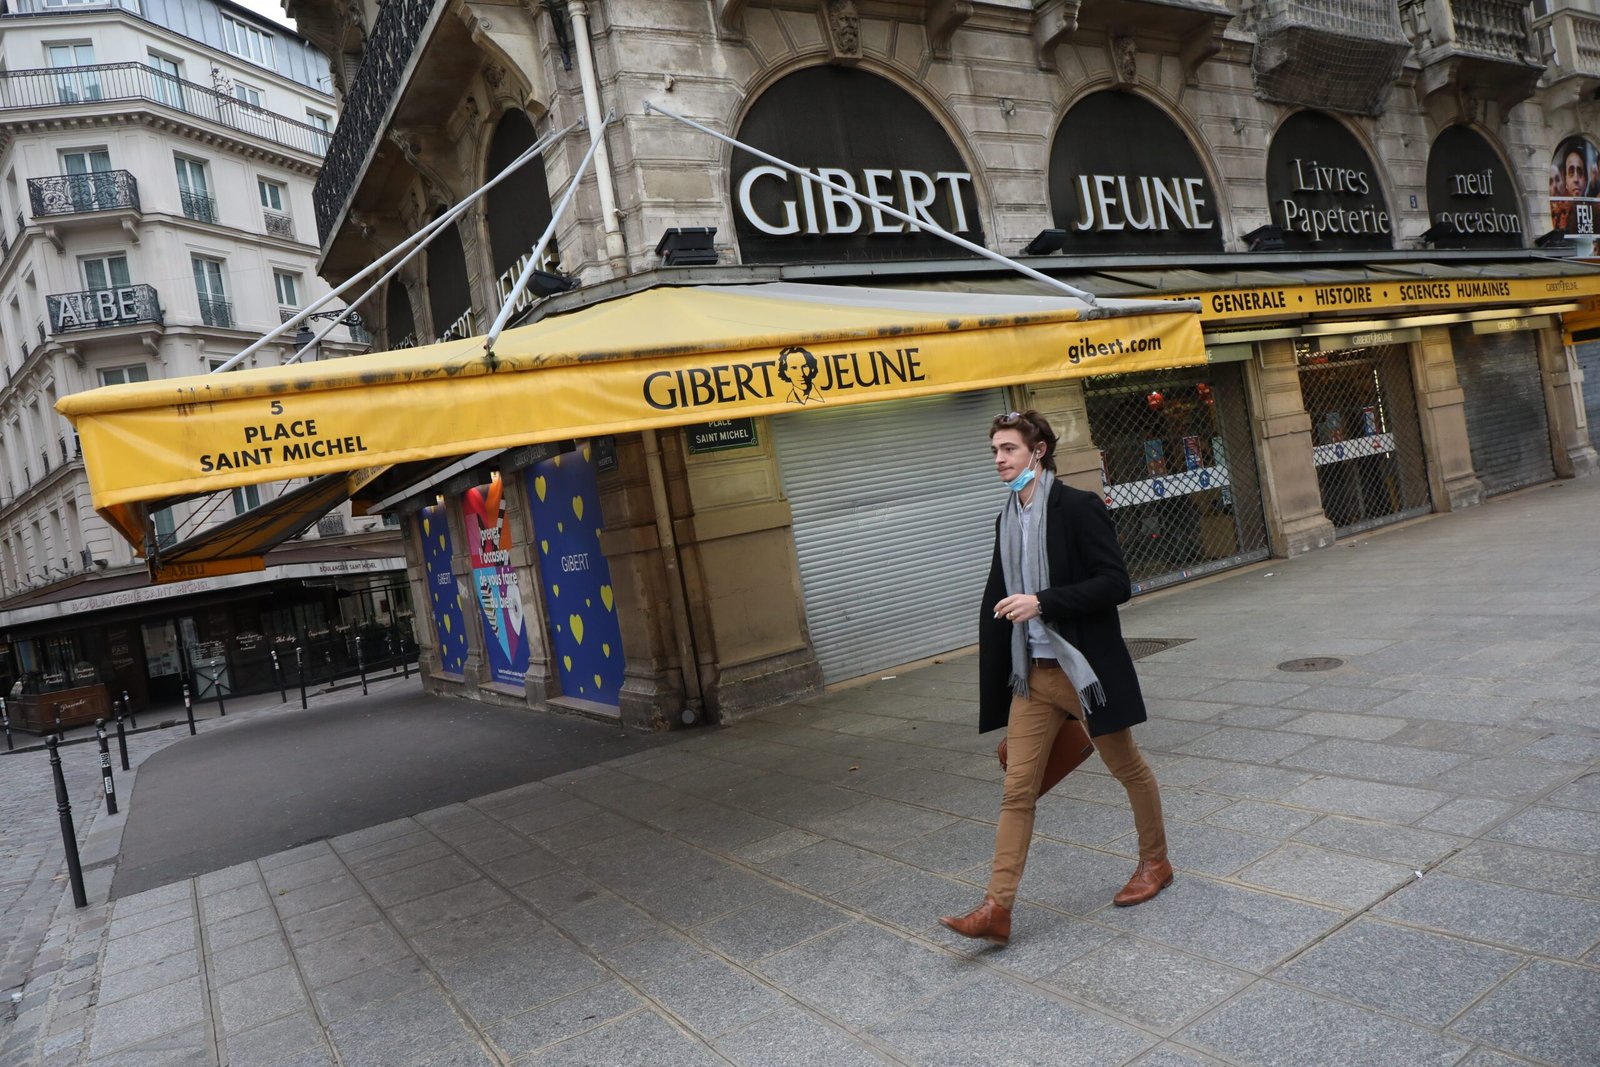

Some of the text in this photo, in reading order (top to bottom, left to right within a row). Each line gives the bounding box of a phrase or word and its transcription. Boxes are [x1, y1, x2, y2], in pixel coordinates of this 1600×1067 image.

[1295, 158, 1369, 195] Livres
[1455, 168, 1494, 196] neuf
[739, 165, 1214, 235] GIBERT JEUNE
[1576, 204, 1593, 224] FEU
[1282, 199, 1391, 241] Papeterie
[58, 288, 138, 327] ALBE
[1211, 291, 1286, 313] GENERALE
[1315, 286, 1373, 306] HISTOIRE
[1400, 283, 1451, 301] SCIENCES
[1456, 281, 1511, 298] HUMAINES
[1068, 336, 1162, 364] gibert.com
[642, 347, 926, 410] GIBERT JEUNE
[270, 400, 284, 415] 5
[244, 419, 318, 444] PLACE
[695, 428, 749, 444] SAINT MICHEL
[708, 419, 732, 428] PLACE
[200, 435, 368, 472] SAINT MICHEL
[488, 573, 502, 586] vous
[501, 567, 518, 585] faire
